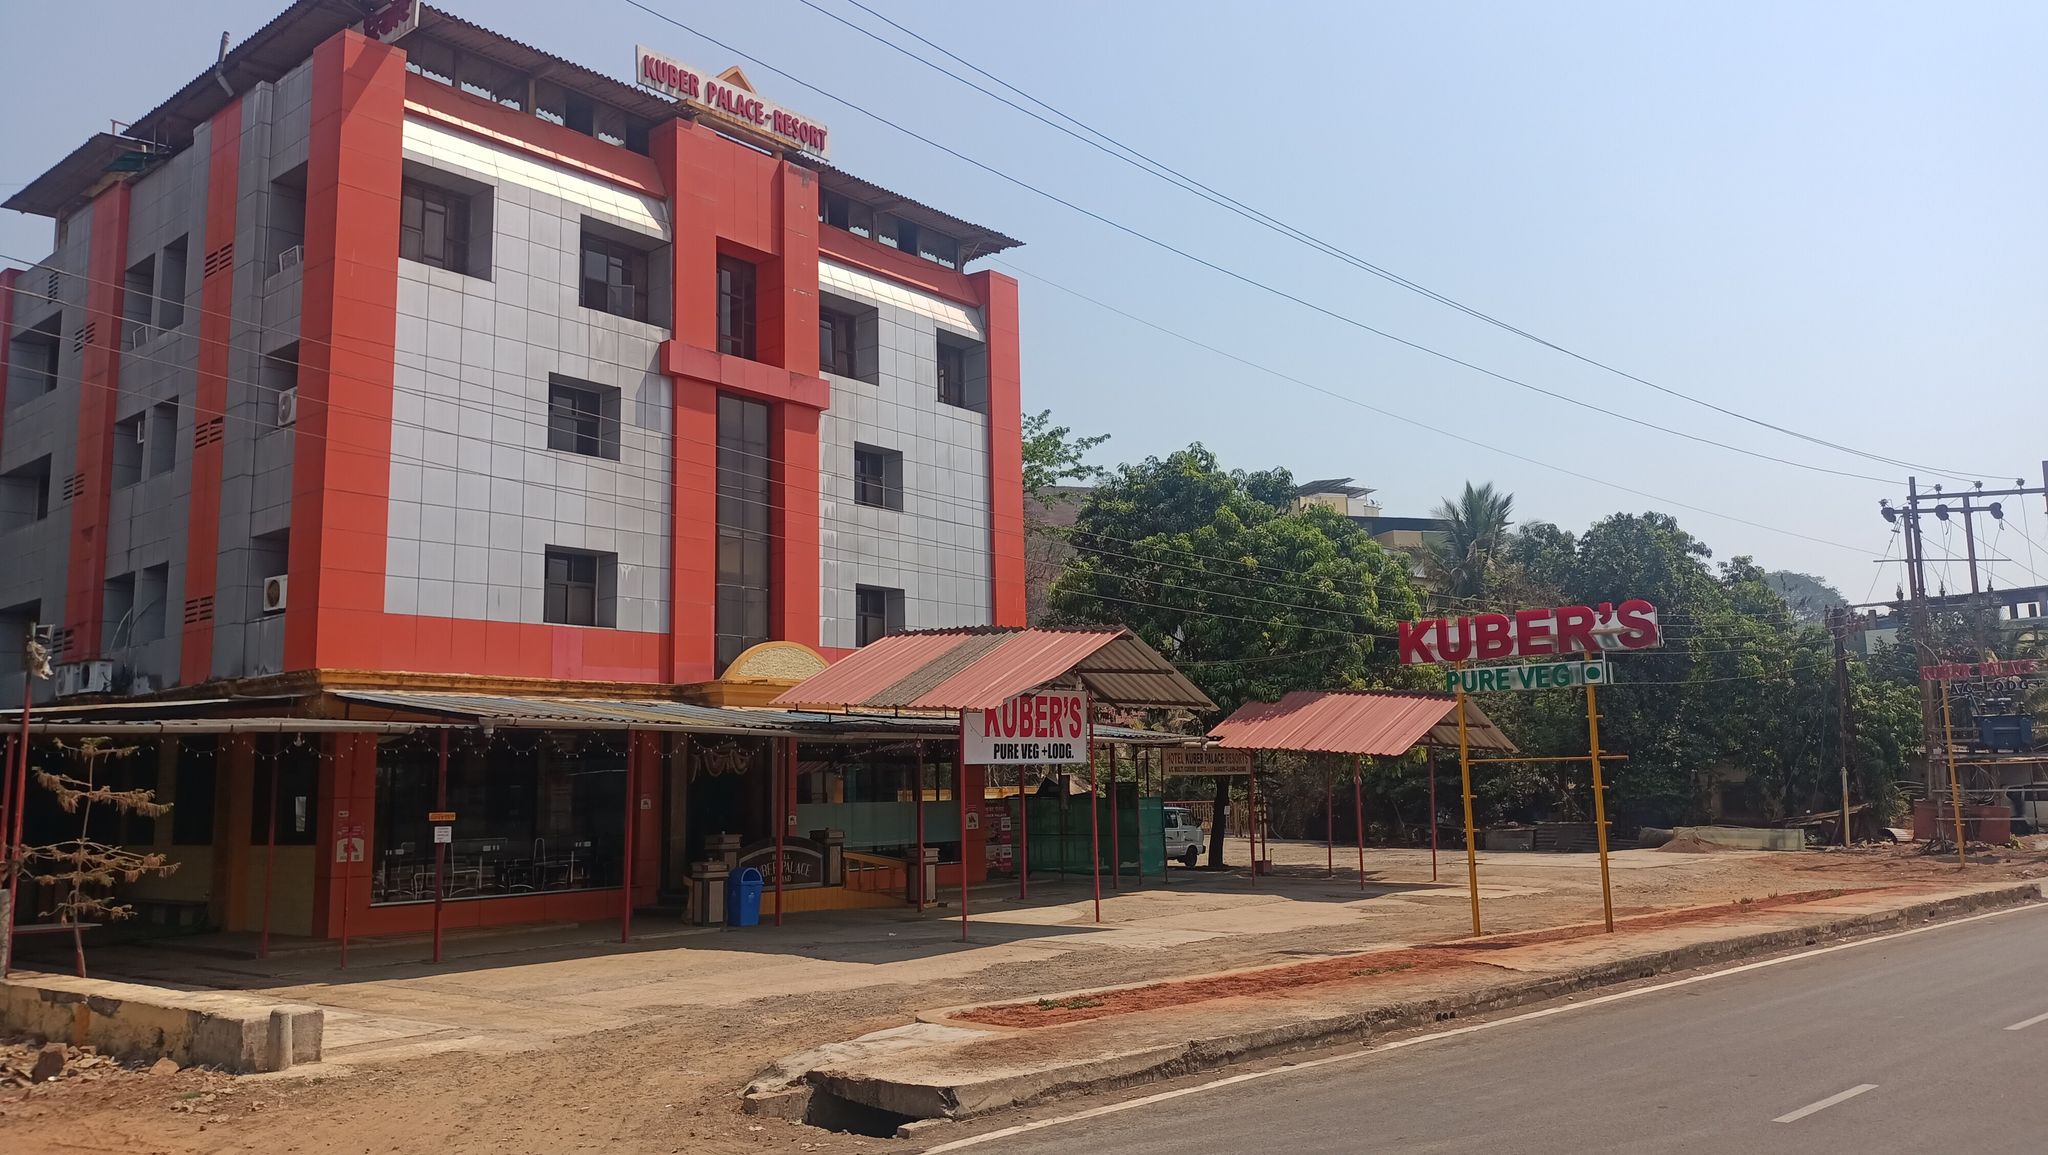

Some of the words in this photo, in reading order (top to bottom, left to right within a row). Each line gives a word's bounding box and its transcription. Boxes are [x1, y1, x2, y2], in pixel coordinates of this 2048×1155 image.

[643, 54, 700, 98] KUBER
[1398, 599, 1658, 664] KUBER'S
[1446, 667, 1511, 694] PURE
[1517, 664, 1571, 689] VEG
[984, 694, 1082, 738] KUBER'S
[994, 743, 1019, 759] PURE
[1021, 743, 1039, 759] VEG
[1166, 752, 1184, 765] HOTEL
[1185, 752, 1204, 765] KUBER
[1204, 752, 1224, 765] PALACE
